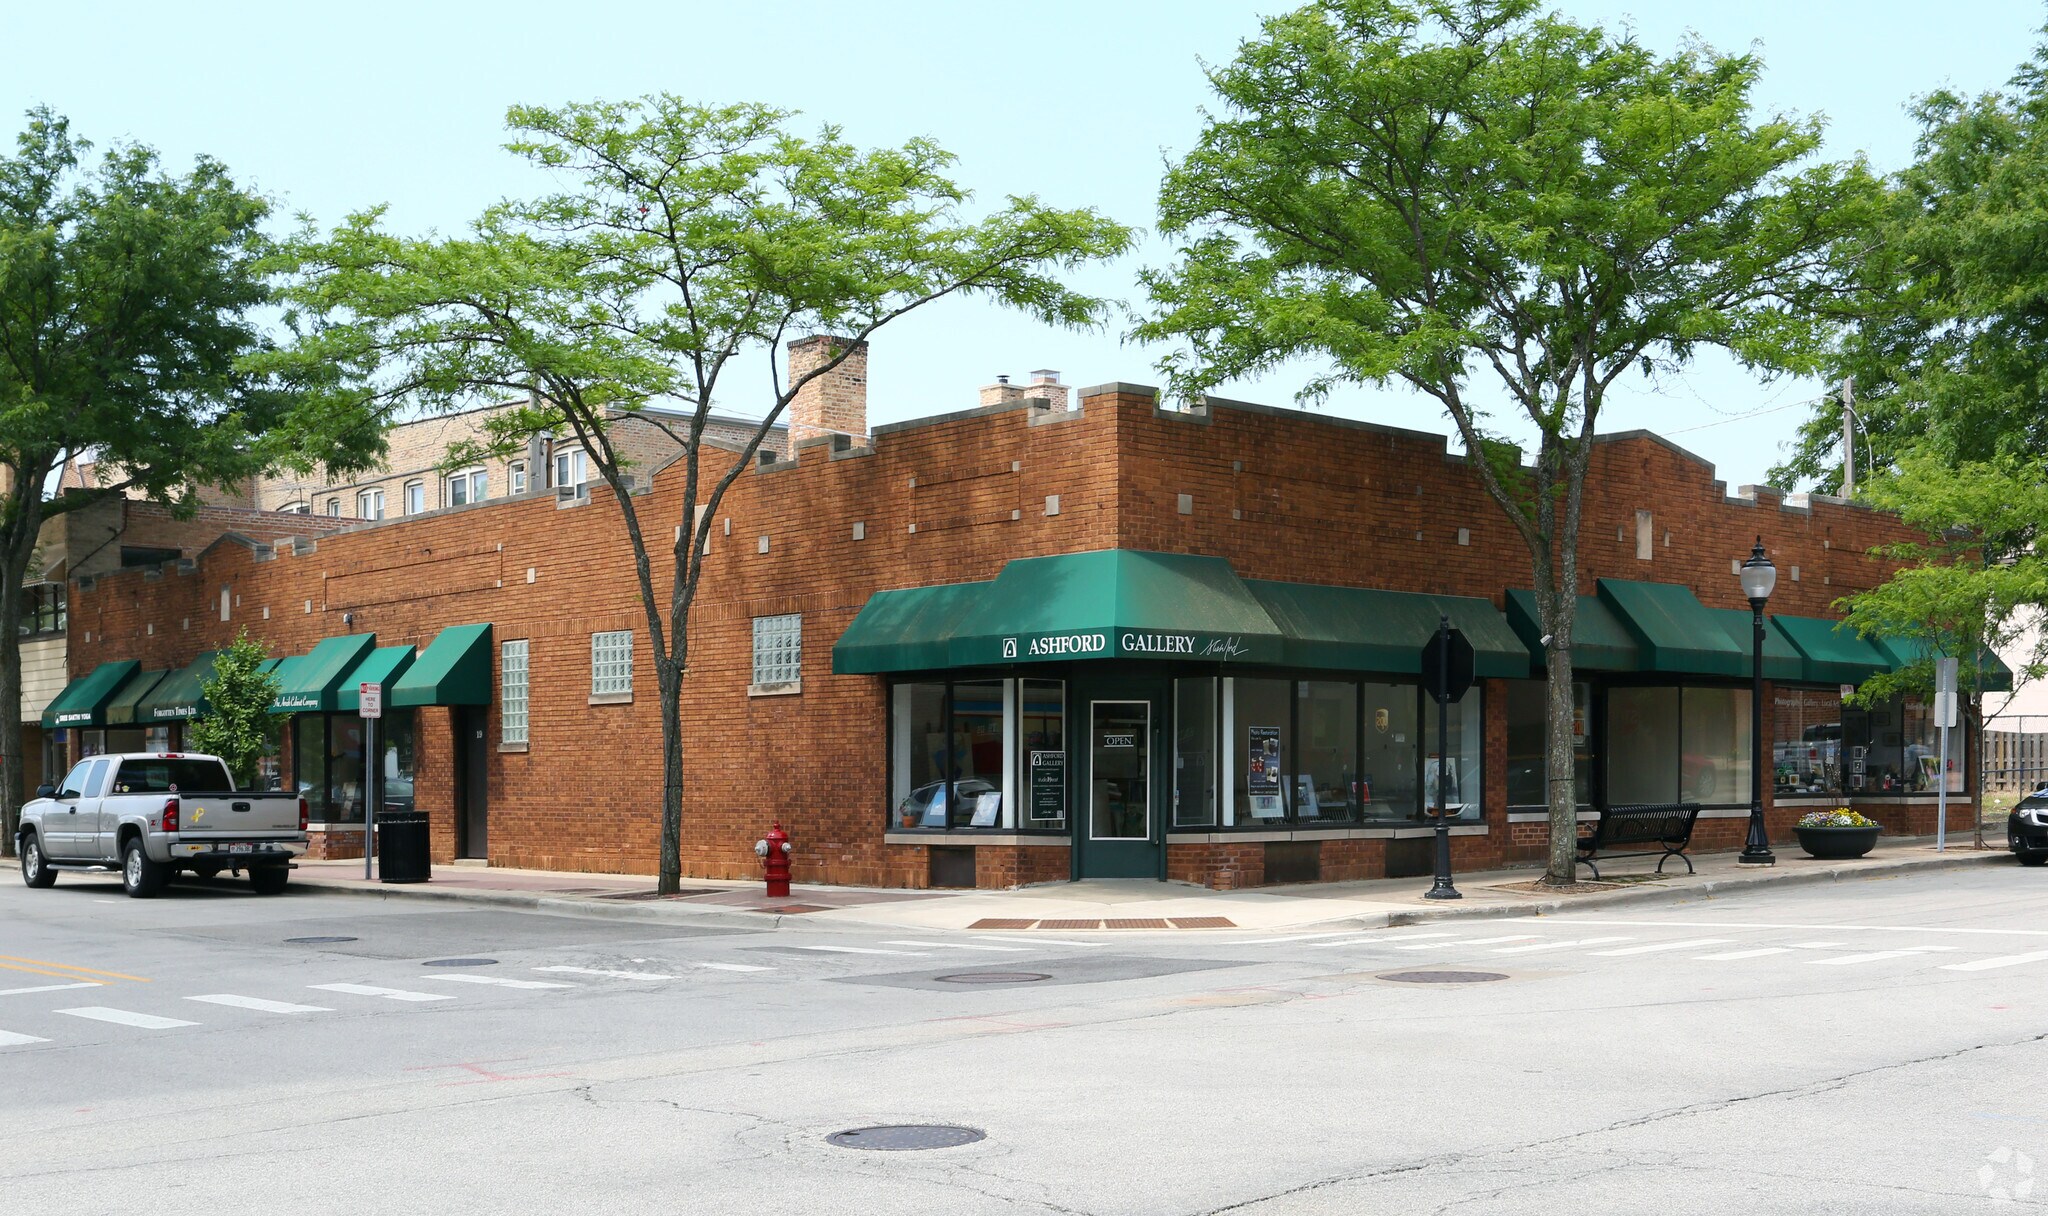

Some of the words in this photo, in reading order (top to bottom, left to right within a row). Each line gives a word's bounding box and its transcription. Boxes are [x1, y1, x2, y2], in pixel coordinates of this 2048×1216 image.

[1029, 634, 1106, 655] ASHFORD
[1121, 633, 1196, 653] GALLERY
[303, 695, 319, 709] Company
[153, 707, 175, 718] FORGOTTEN
[175, 706, 188, 716] TIMES
[1106, 737, 1132, 745] OPEN
